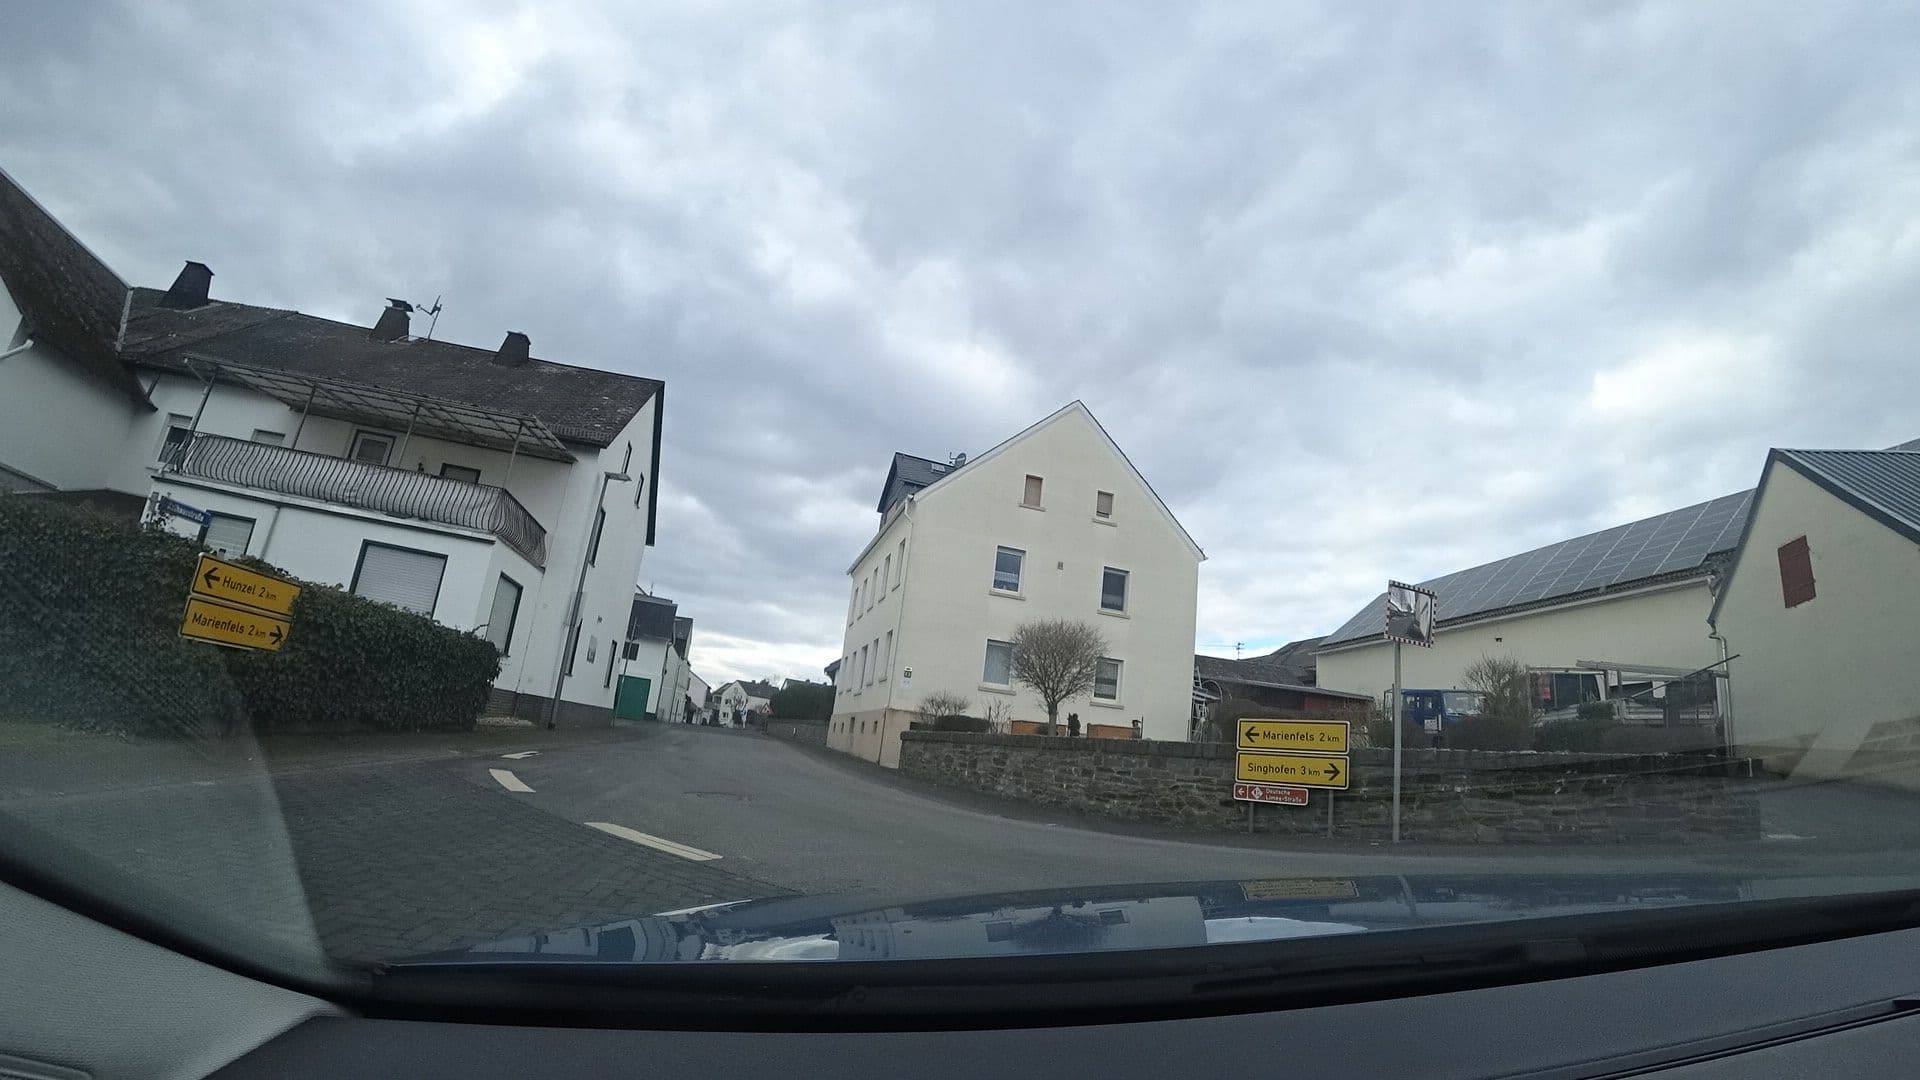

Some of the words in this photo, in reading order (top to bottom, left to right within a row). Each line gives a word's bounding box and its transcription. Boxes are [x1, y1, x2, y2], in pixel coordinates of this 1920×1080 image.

[222, 575, 257, 595] Hunzel
[258, 586, 266, 598] 2
[265, 591, 277, 601] km
[191, 612, 245, 634] Marienfels
[247, 624, 256, 636] 2
[255, 628, 267, 639] km
[1262, 730, 1315, 742] Marienfels
[1319, 732, 1325, 742] 2
[1327, 735, 1340, 743] km
[1247, 762, 1296, 775] Singhofen
[1300, 765, 1306, 775] 3
[1308, 767, 1321, 776] km
